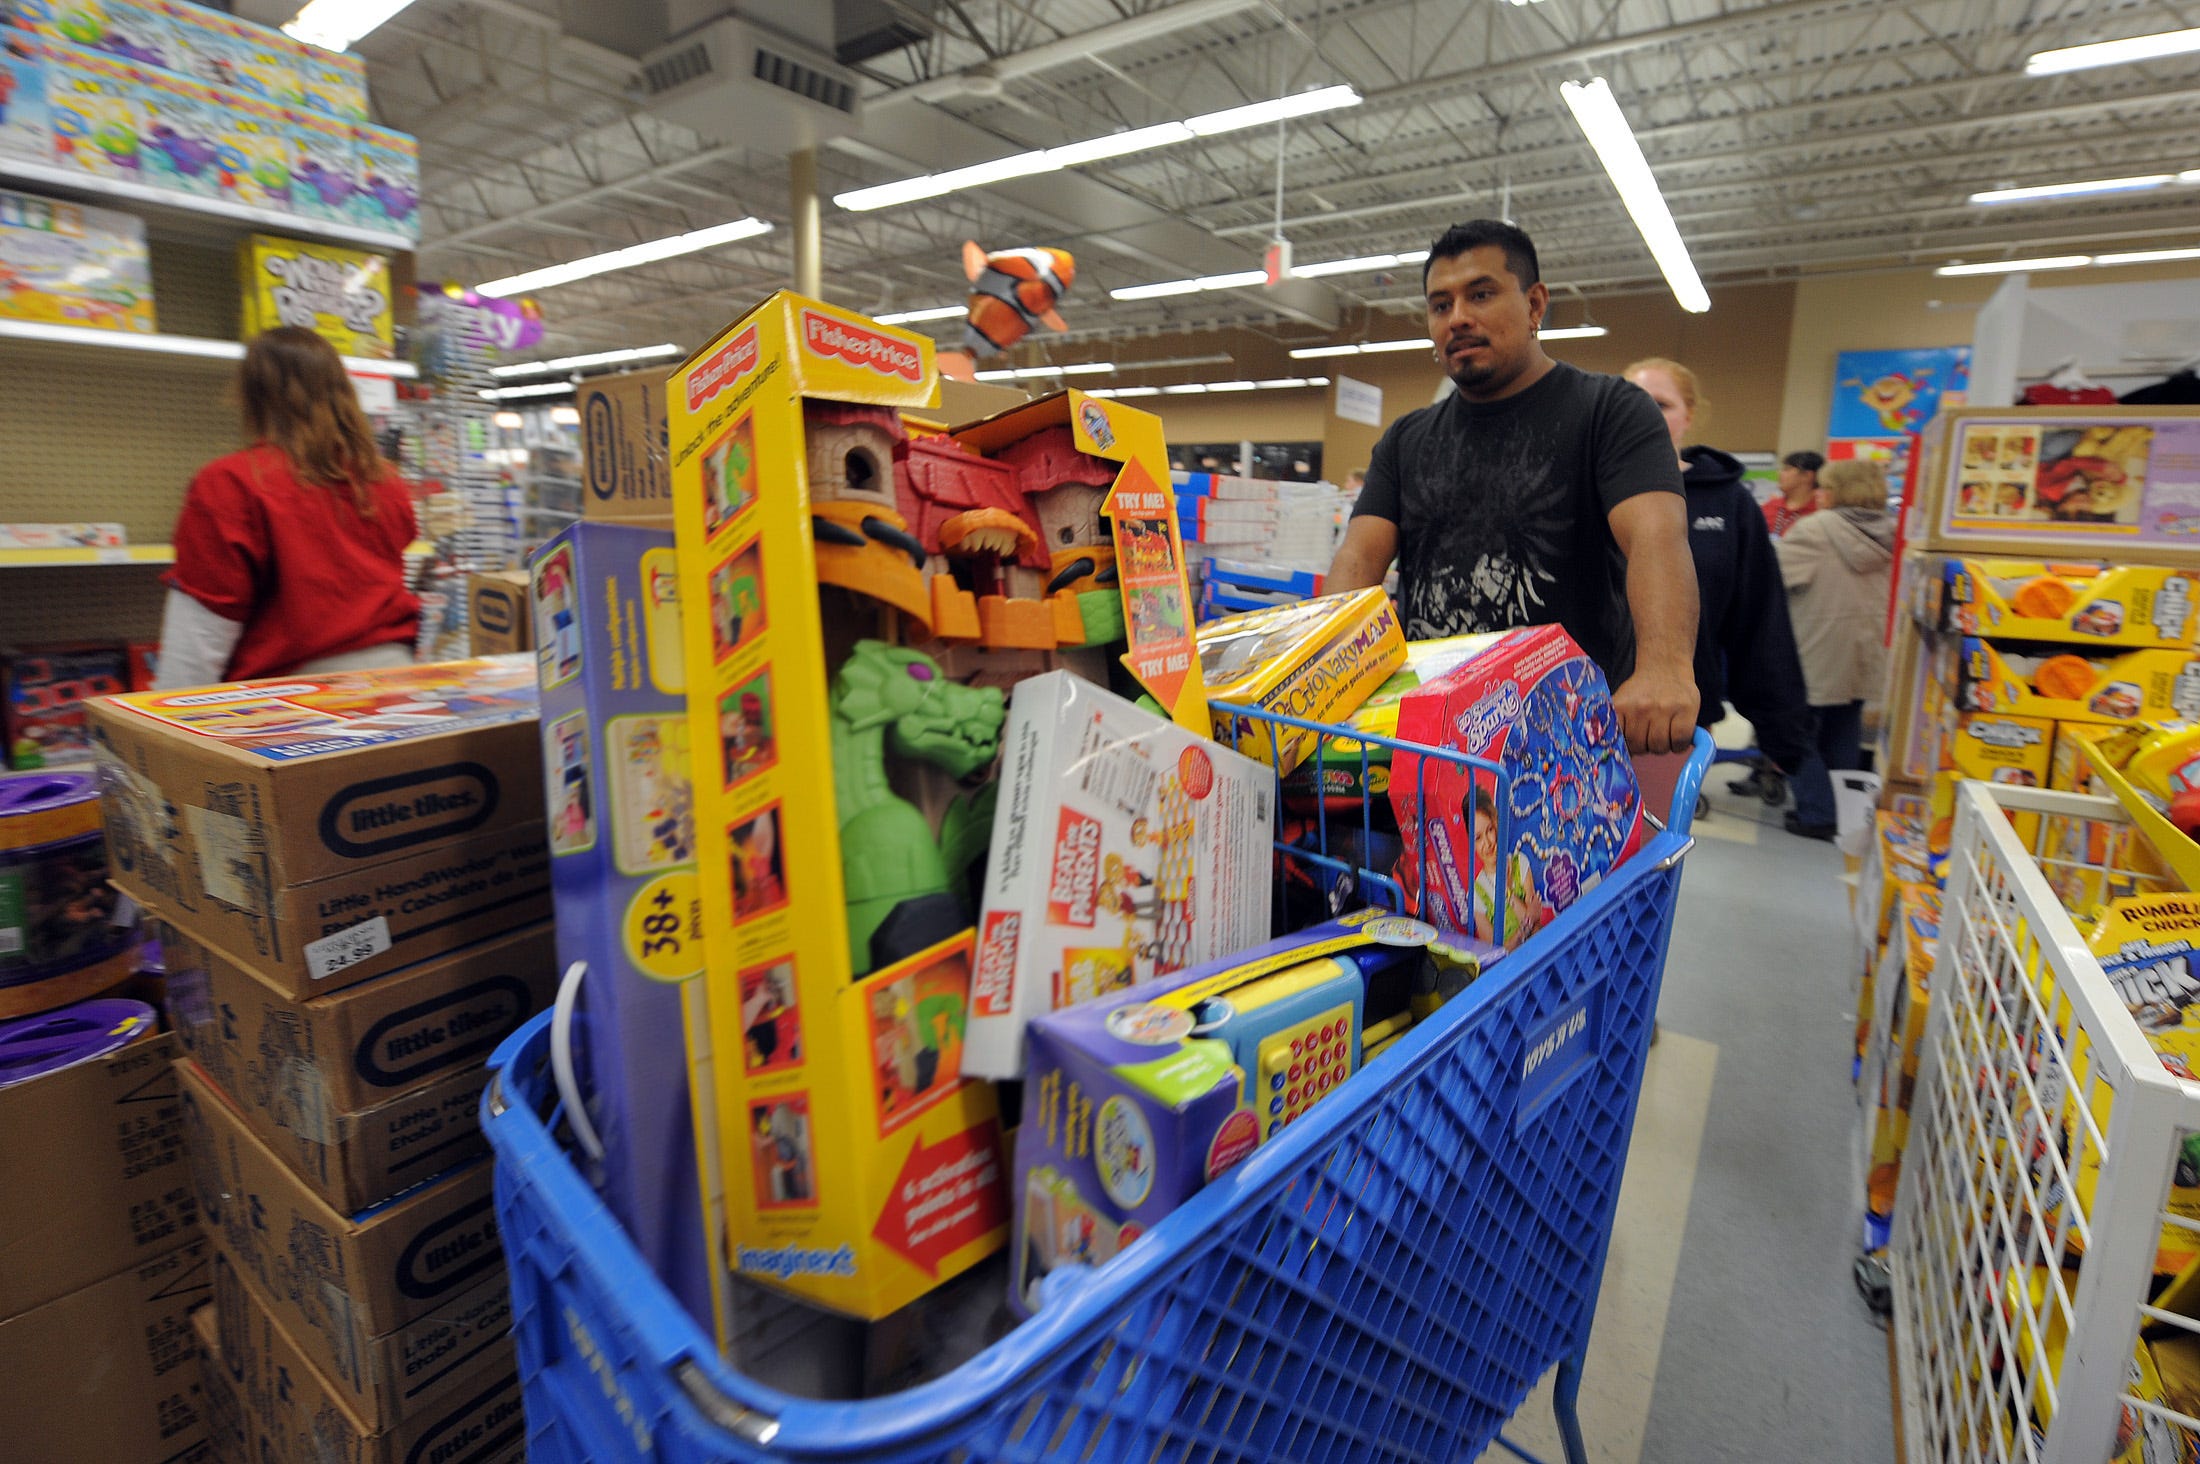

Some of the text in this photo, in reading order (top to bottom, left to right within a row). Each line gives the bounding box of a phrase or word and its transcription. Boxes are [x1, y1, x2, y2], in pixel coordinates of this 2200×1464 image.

[689, 338, 757, 397] Fisher-Price
[808, 318, 918, 371] Fisher-Price
[706, 415, 724, 435] the
[1115, 492, 1166, 510] TRY ME!
[1138, 652, 1190, 679] TRY ME!
[1469, 694, 1520, 754] Sparkle
[352, 790, 477, 833] little tikes
[1053, 841, 1079, 904] BEAT
[1068, 818, 1099, 925] PARENTS
[319, 894, 371, 918] Little
[643, 888, 680, 958] 38+
[976, 941, 997, 999] BEAT
[988, 913, 1020, 1013] PARENTS
[388, 1004, 510, 1061] little tikes
[1523, 1031, 1555, 1080] TOYS
[389, 1107, 438, 1133] Little
[425, 1230, 482, 1272] little
[737, 1242, 857, 1280] imaginext
[429, 1425, 484, 1464] little
